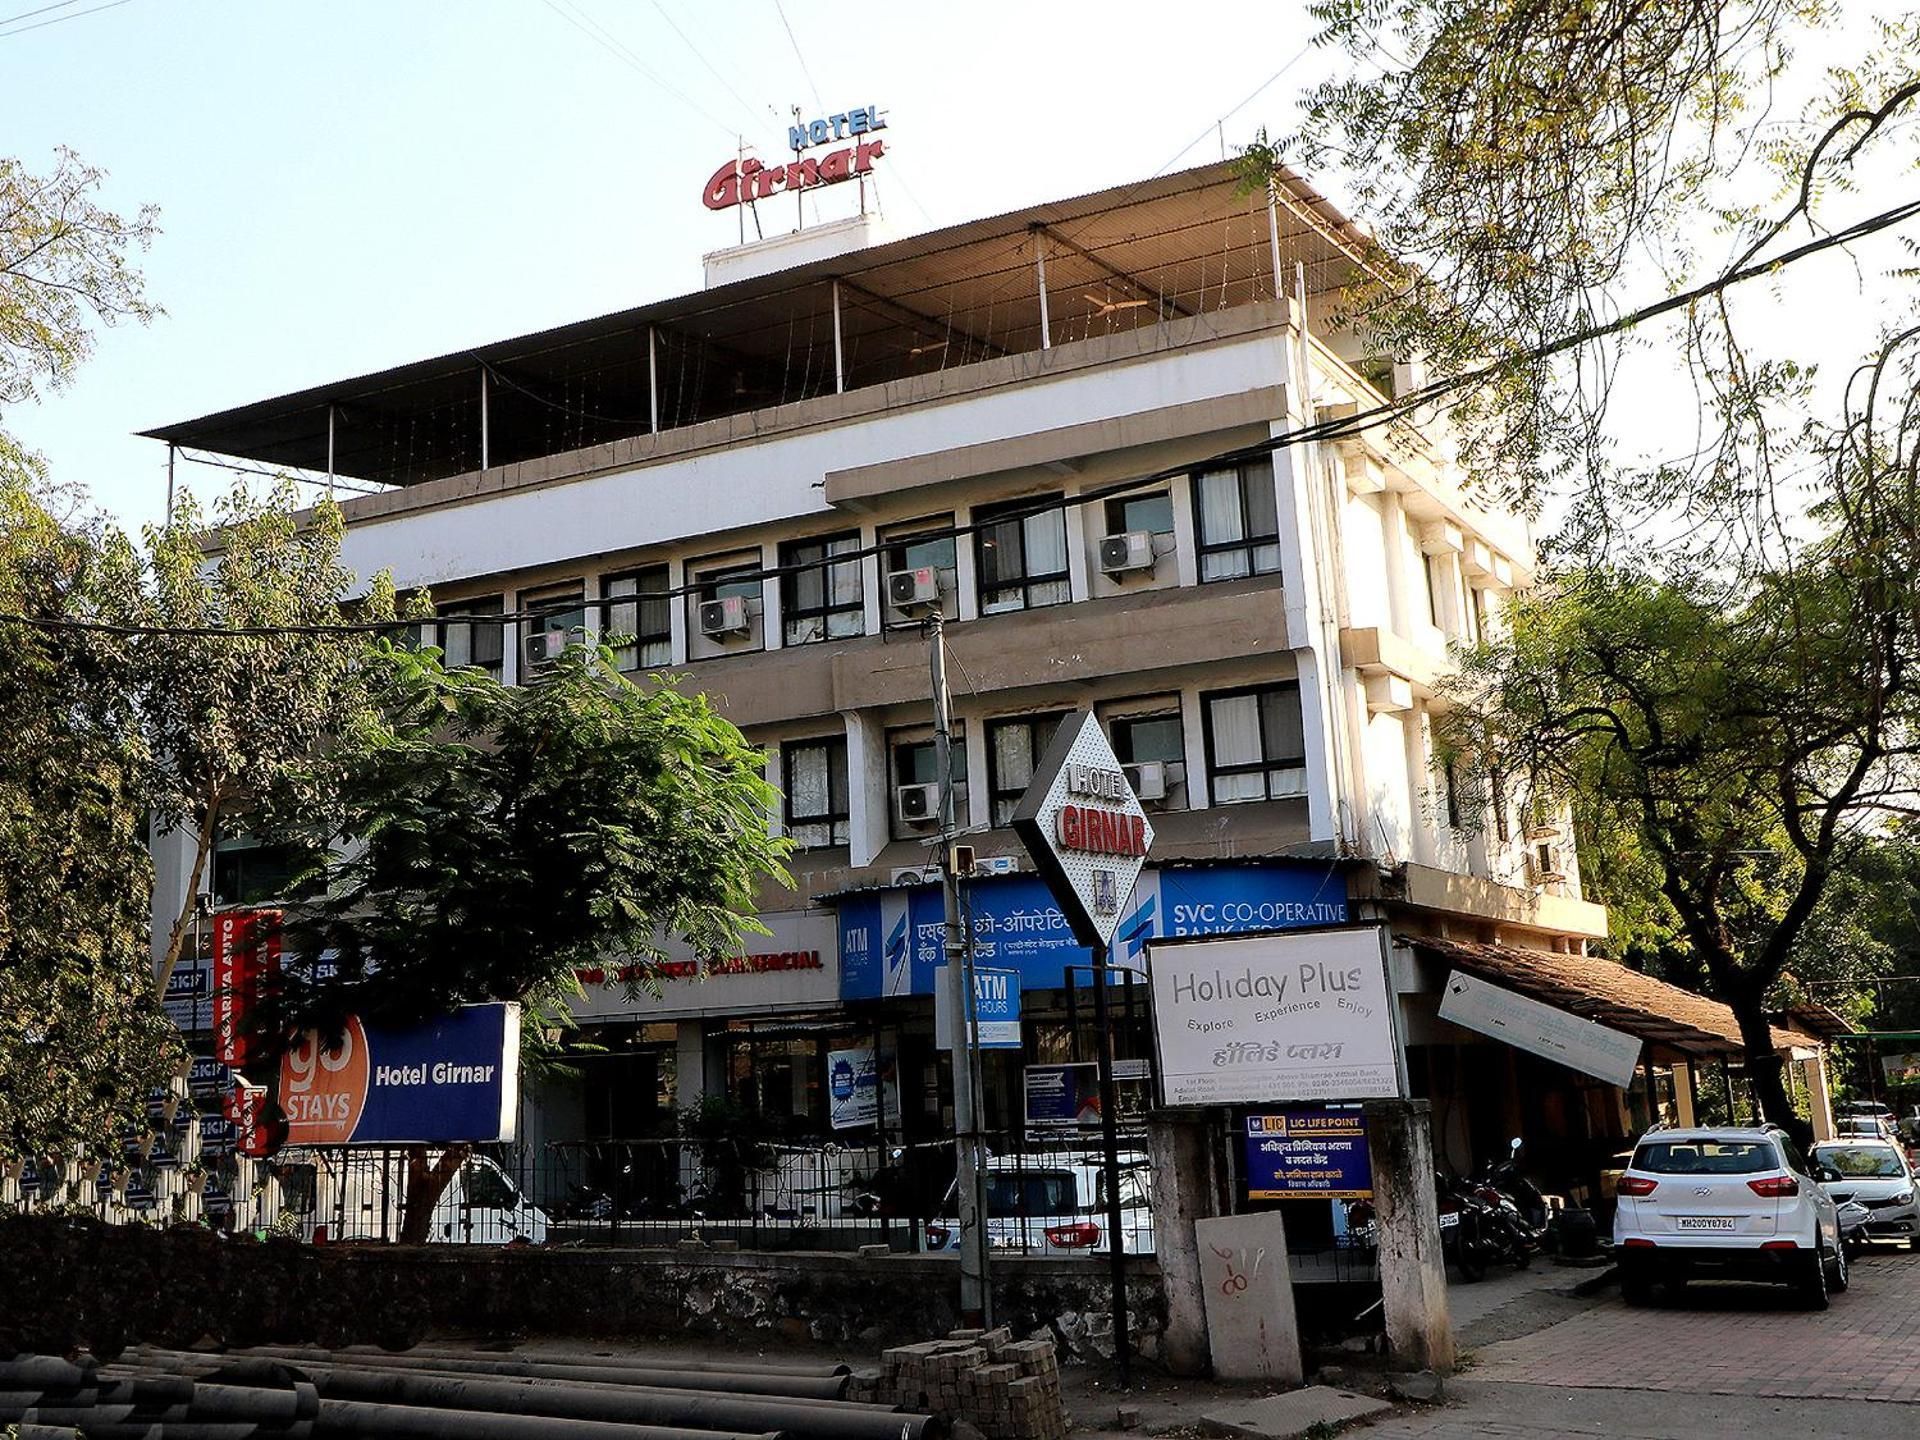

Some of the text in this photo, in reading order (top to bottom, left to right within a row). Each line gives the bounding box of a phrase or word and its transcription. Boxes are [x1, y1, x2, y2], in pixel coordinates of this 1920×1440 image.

[788, 104, 888, 152] HOTEL
[702, 139, 886, 210] Girnar
[1058, 804, 1147, 857] GIRNAR
[1174, 902, 1346, 923] SVC CO-OPERATIVE
[221, 918, 234, 967] AUTO
[845, 927, 868, 953] ATM
[973, 975, 1007, 1000] ATM
[1173, 962, 1362, 1004] Holiday Plus
[981, 1000, 1008, 1013] HOURS
[1187, 998, 1373, 1033] Explore Experience Enjoy
[375, 1062, 494, 1086] Hotel Girnar
[287, 1093, 351, 1121] STAYS
[1264, 1117, 1285, 1130] LIC
[1289, 1118, 1359, 1128] LIC LIFE POINT
